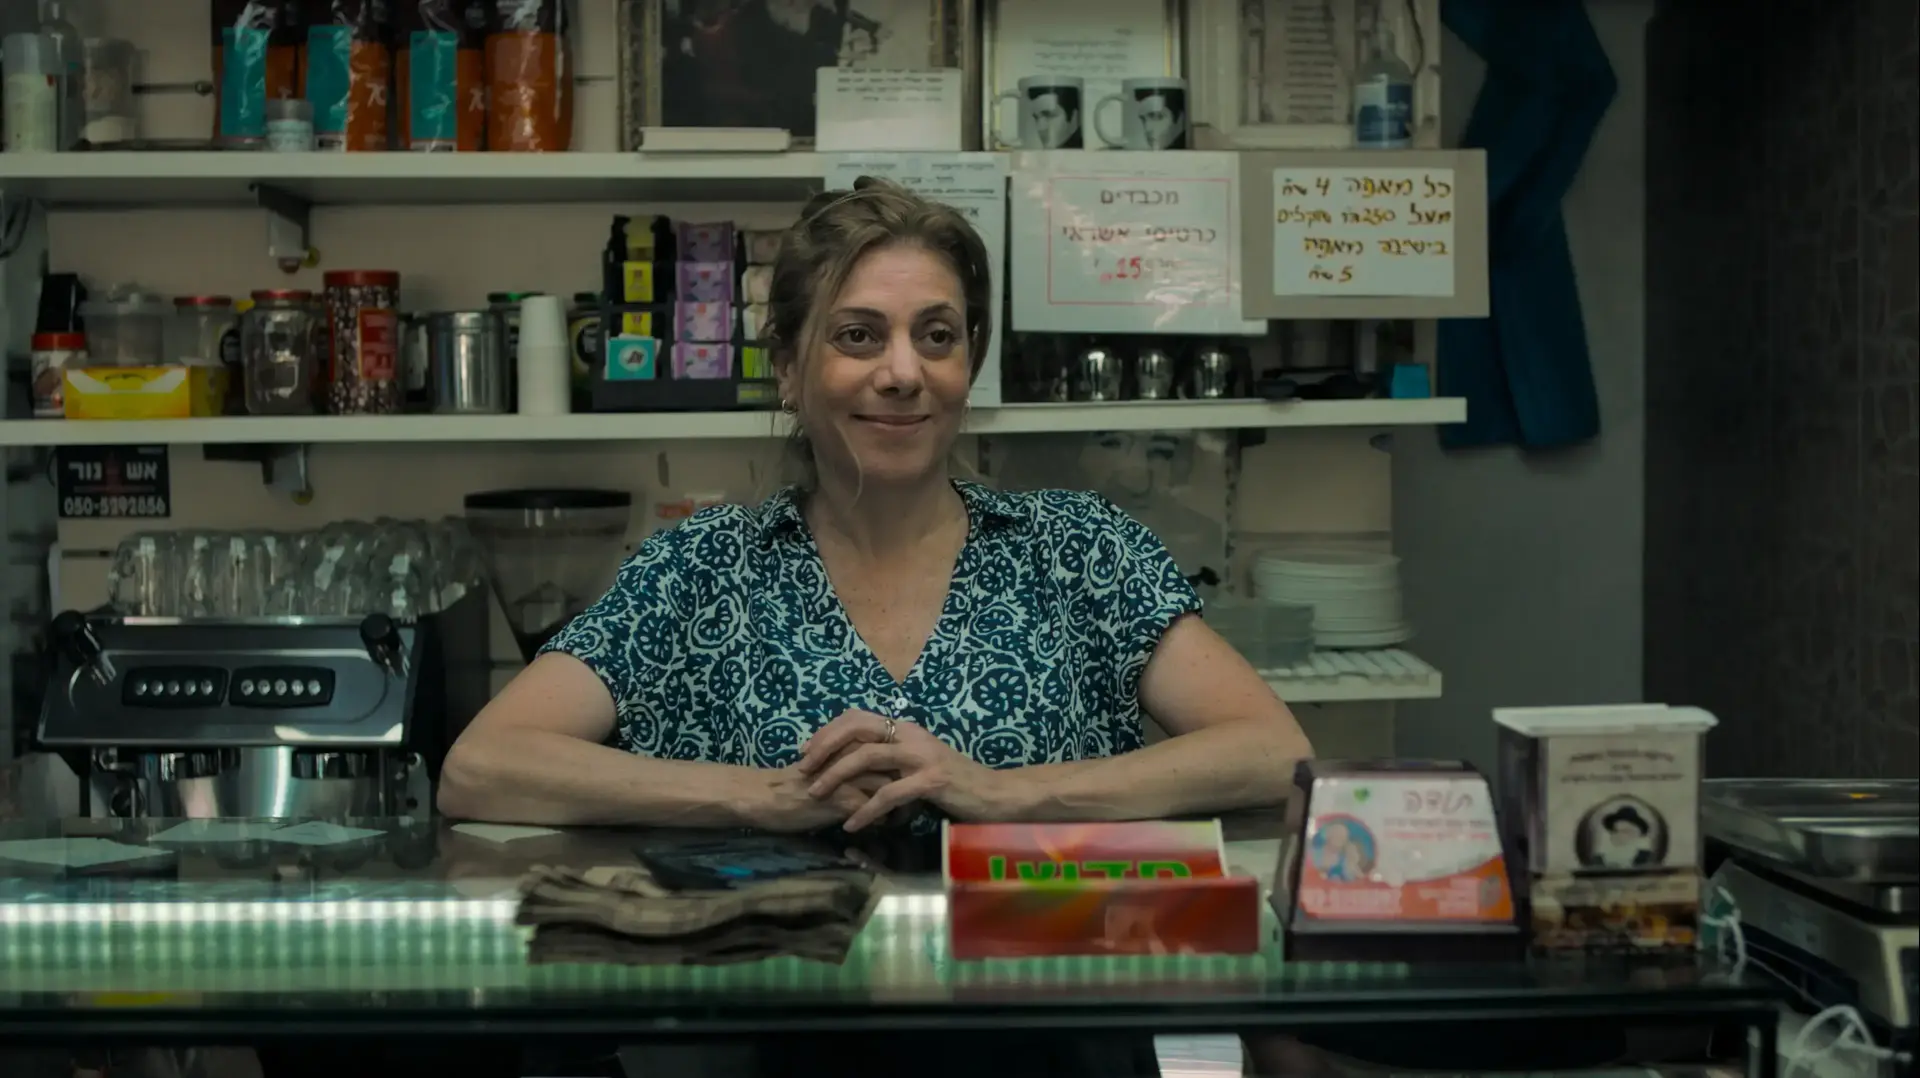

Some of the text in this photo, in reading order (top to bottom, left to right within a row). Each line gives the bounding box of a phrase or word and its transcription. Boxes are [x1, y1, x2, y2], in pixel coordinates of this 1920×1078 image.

[1316, 175, 1330, 196] 4
[1343, 176, 1413, 198] מאפה
[1424, 174, 1452, 198] כל
[1100, 189, 1180, 205] מכבדים
[1062, 225, 1217, 243] כרטיסי אשראי
[1303, 236, 1365, 259] מאפה
[1339, 265, 1354, 284] 5
[68, 461, 158, 481] אש נור
[1403, 790, 1474, 815] תודה
